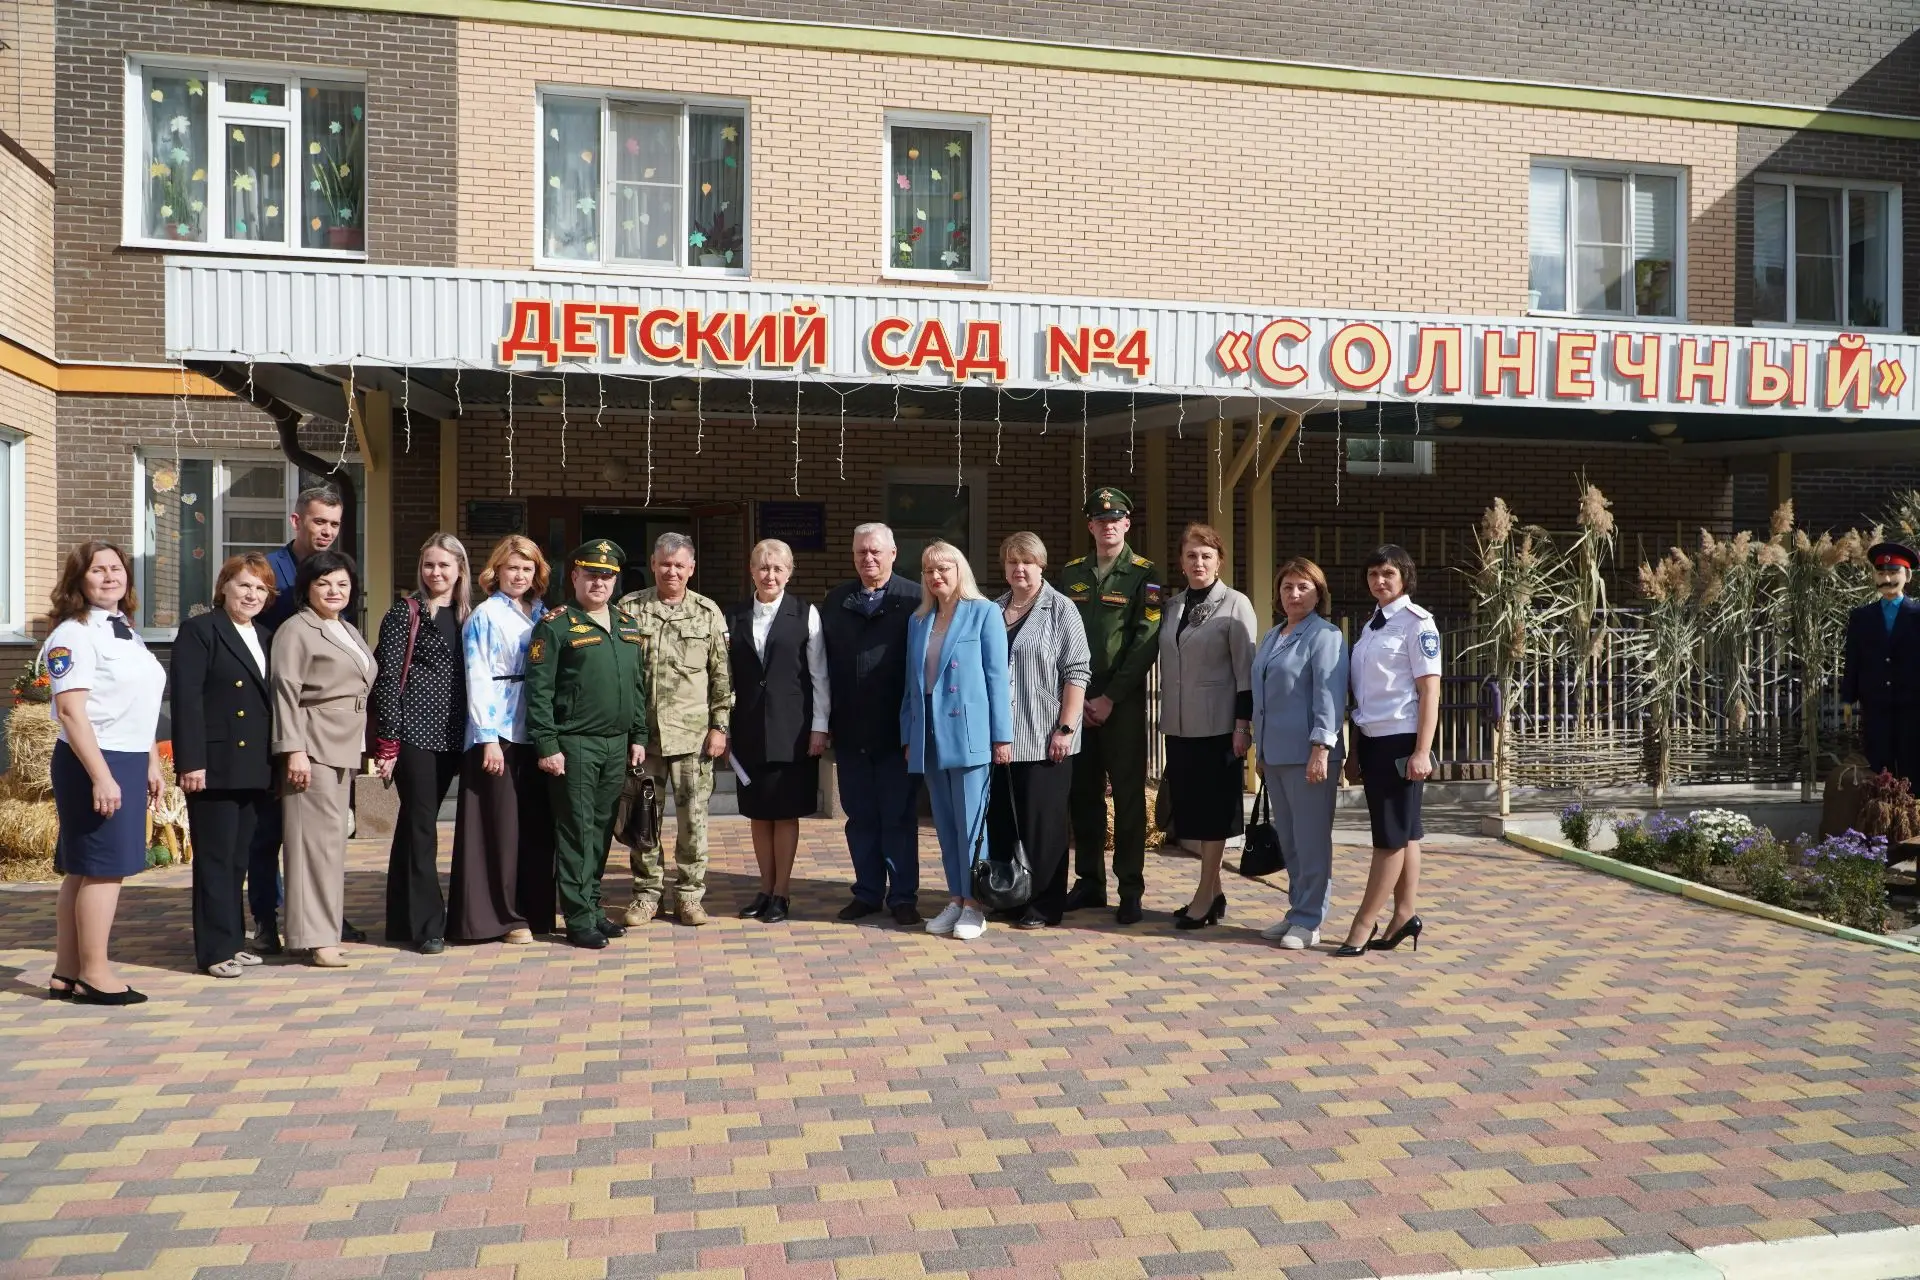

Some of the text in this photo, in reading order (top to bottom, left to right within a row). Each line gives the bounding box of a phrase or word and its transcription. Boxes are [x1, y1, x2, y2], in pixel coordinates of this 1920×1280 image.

[498, 299, 1908, 410] ДЕТСКИЙ САД №4 «СОЛНЕЧНЫЙ»
